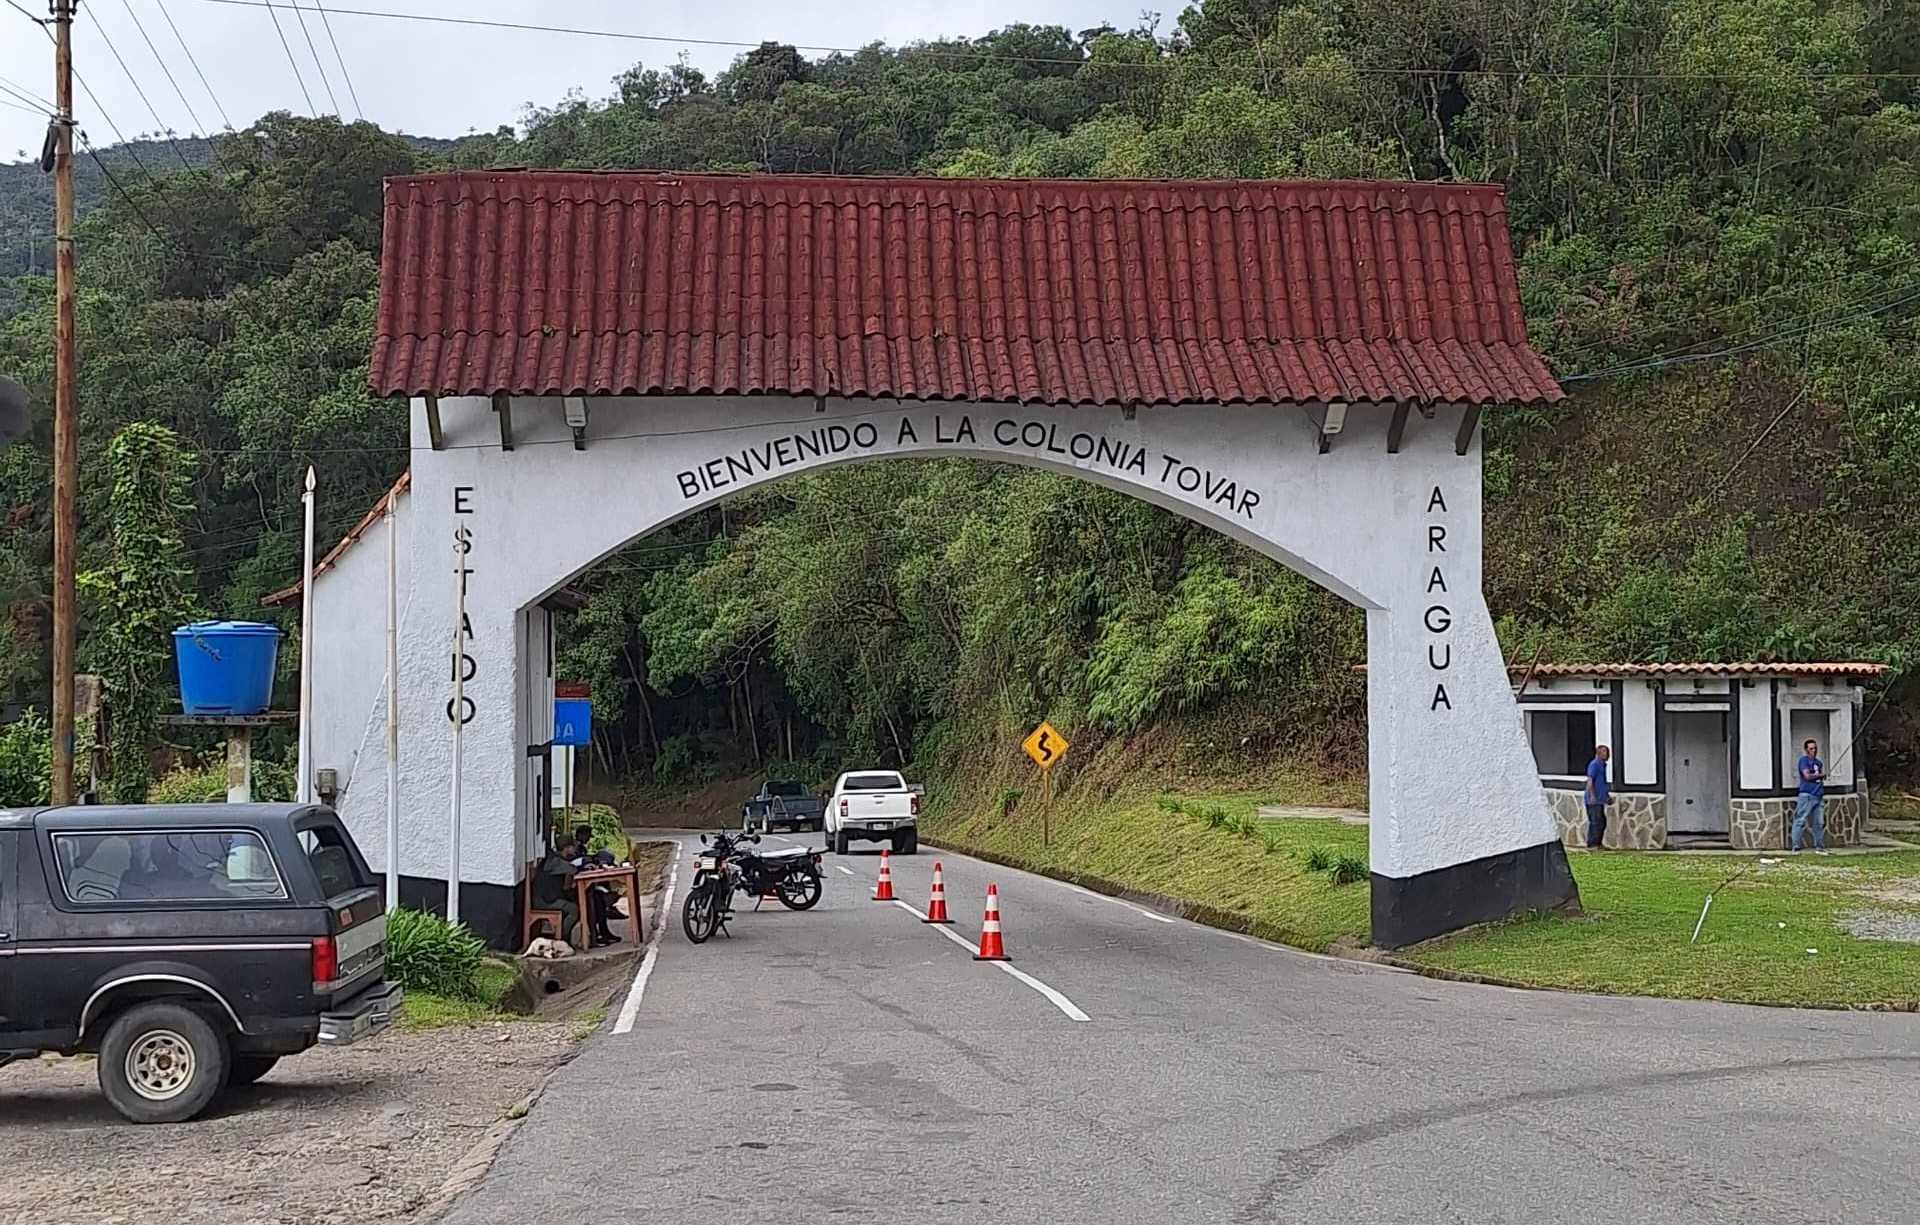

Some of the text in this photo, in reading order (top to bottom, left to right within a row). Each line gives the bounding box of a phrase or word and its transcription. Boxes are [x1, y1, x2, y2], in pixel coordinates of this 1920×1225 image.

[676, 415, 1260, 519] BIENVENIDO A LA COLONIA TOVAR
[446, 486, 477, 727] ESTADO
[1424, 485, 1452, 711] ARAGUA
